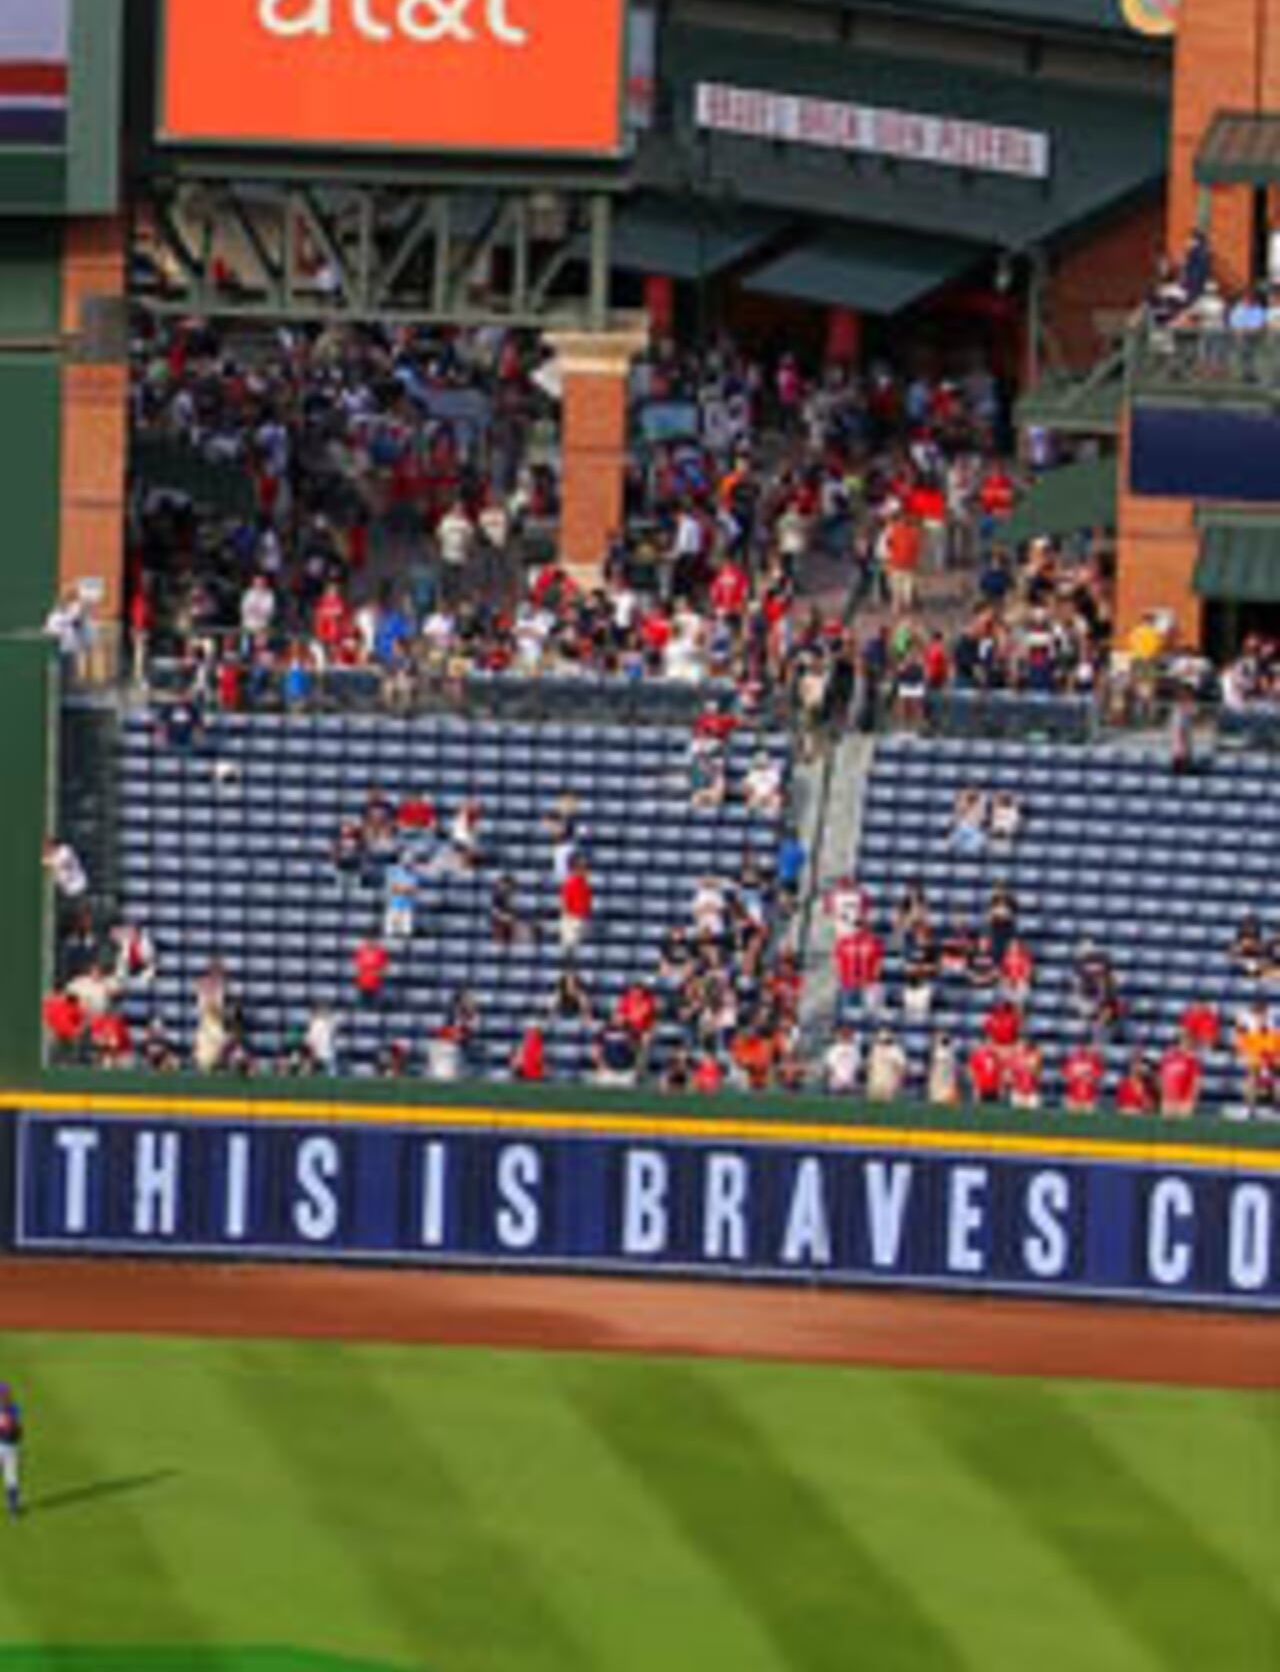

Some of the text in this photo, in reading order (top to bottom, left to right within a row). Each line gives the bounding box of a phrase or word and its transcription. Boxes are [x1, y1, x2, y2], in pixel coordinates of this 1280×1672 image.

[53, 1127, 339, 1241] THIS
[421, 1141, 541, 1250] IS
[621, 1148, 1071, 1278] BRAVES
